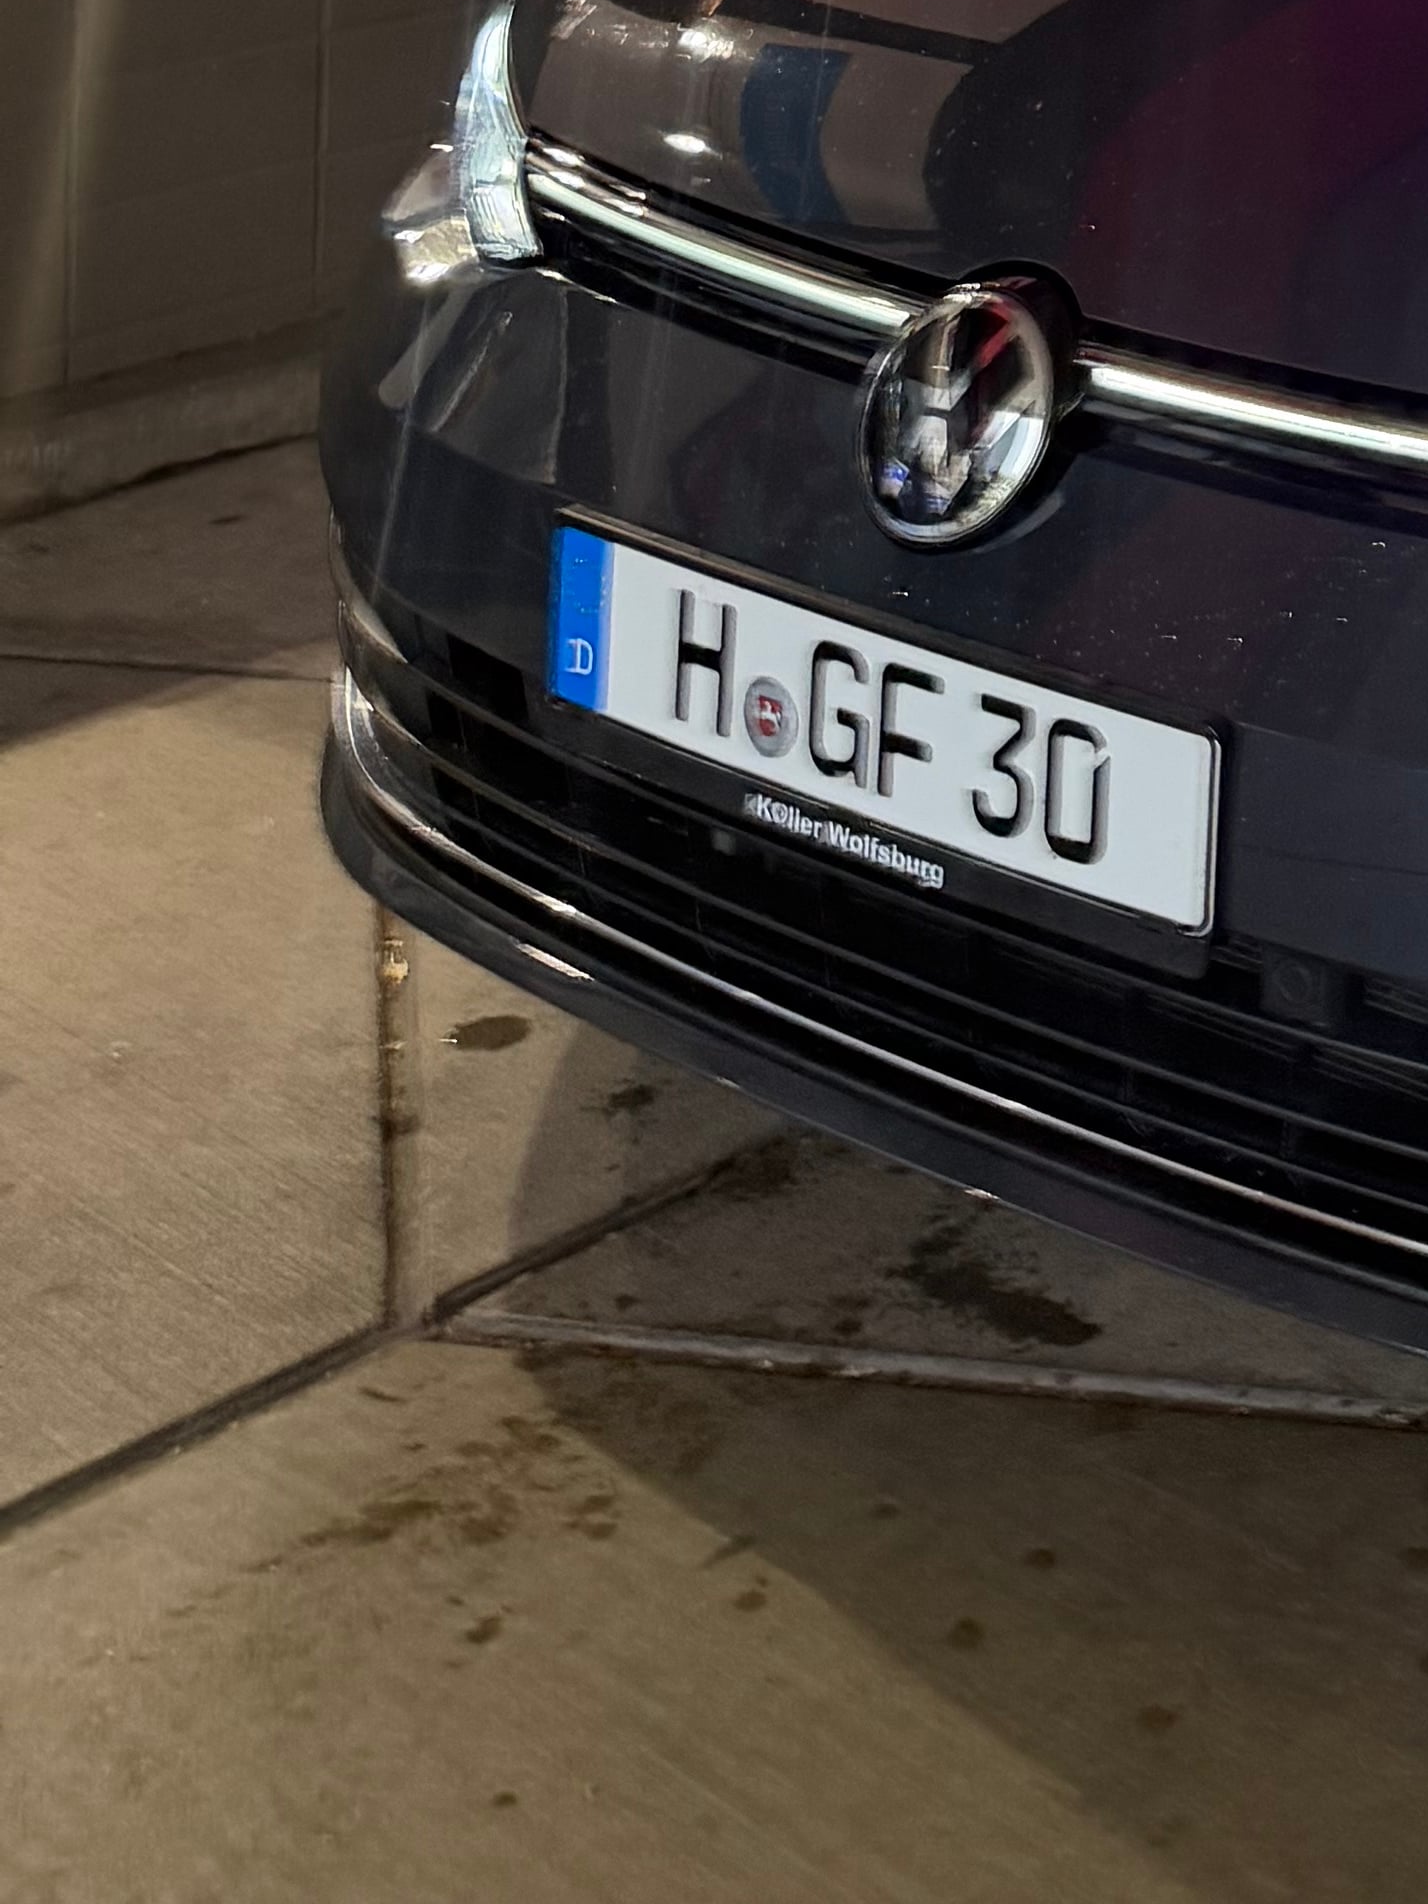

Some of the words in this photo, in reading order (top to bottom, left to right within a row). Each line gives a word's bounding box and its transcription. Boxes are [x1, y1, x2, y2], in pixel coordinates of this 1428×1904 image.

[565, 636, 594, 677] D
[674, 589, 738, 739] H
[809, 640, 946, 797] GF
[972, 693, 1112, 866] 30
[825, 819, 944, 890] Wolfsburg
